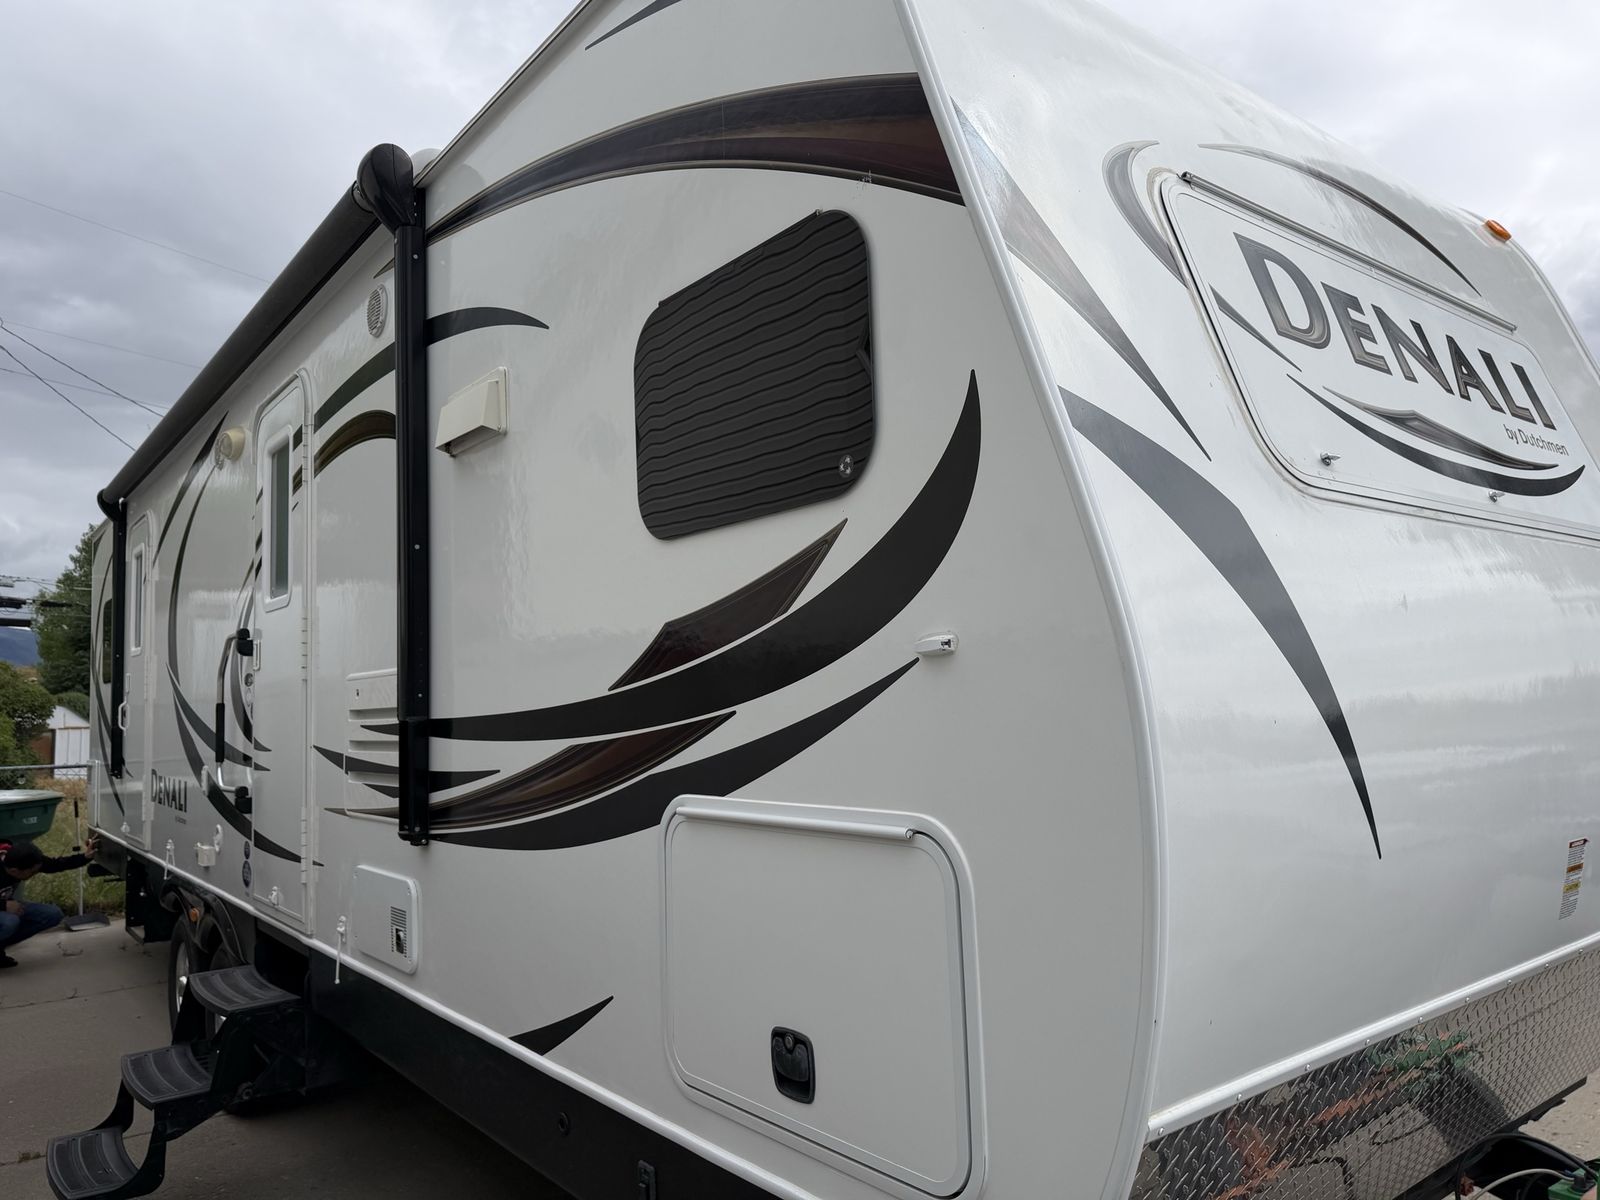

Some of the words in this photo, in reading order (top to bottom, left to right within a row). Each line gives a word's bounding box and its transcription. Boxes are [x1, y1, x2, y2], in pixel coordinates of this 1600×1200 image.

[1233, 232, 1557, 431] DENALI
[1503, 424, 1519, 445] by
[1518, 428, 1569, 457] Dutchmen
[151, 768, 187, 813] DENALI
